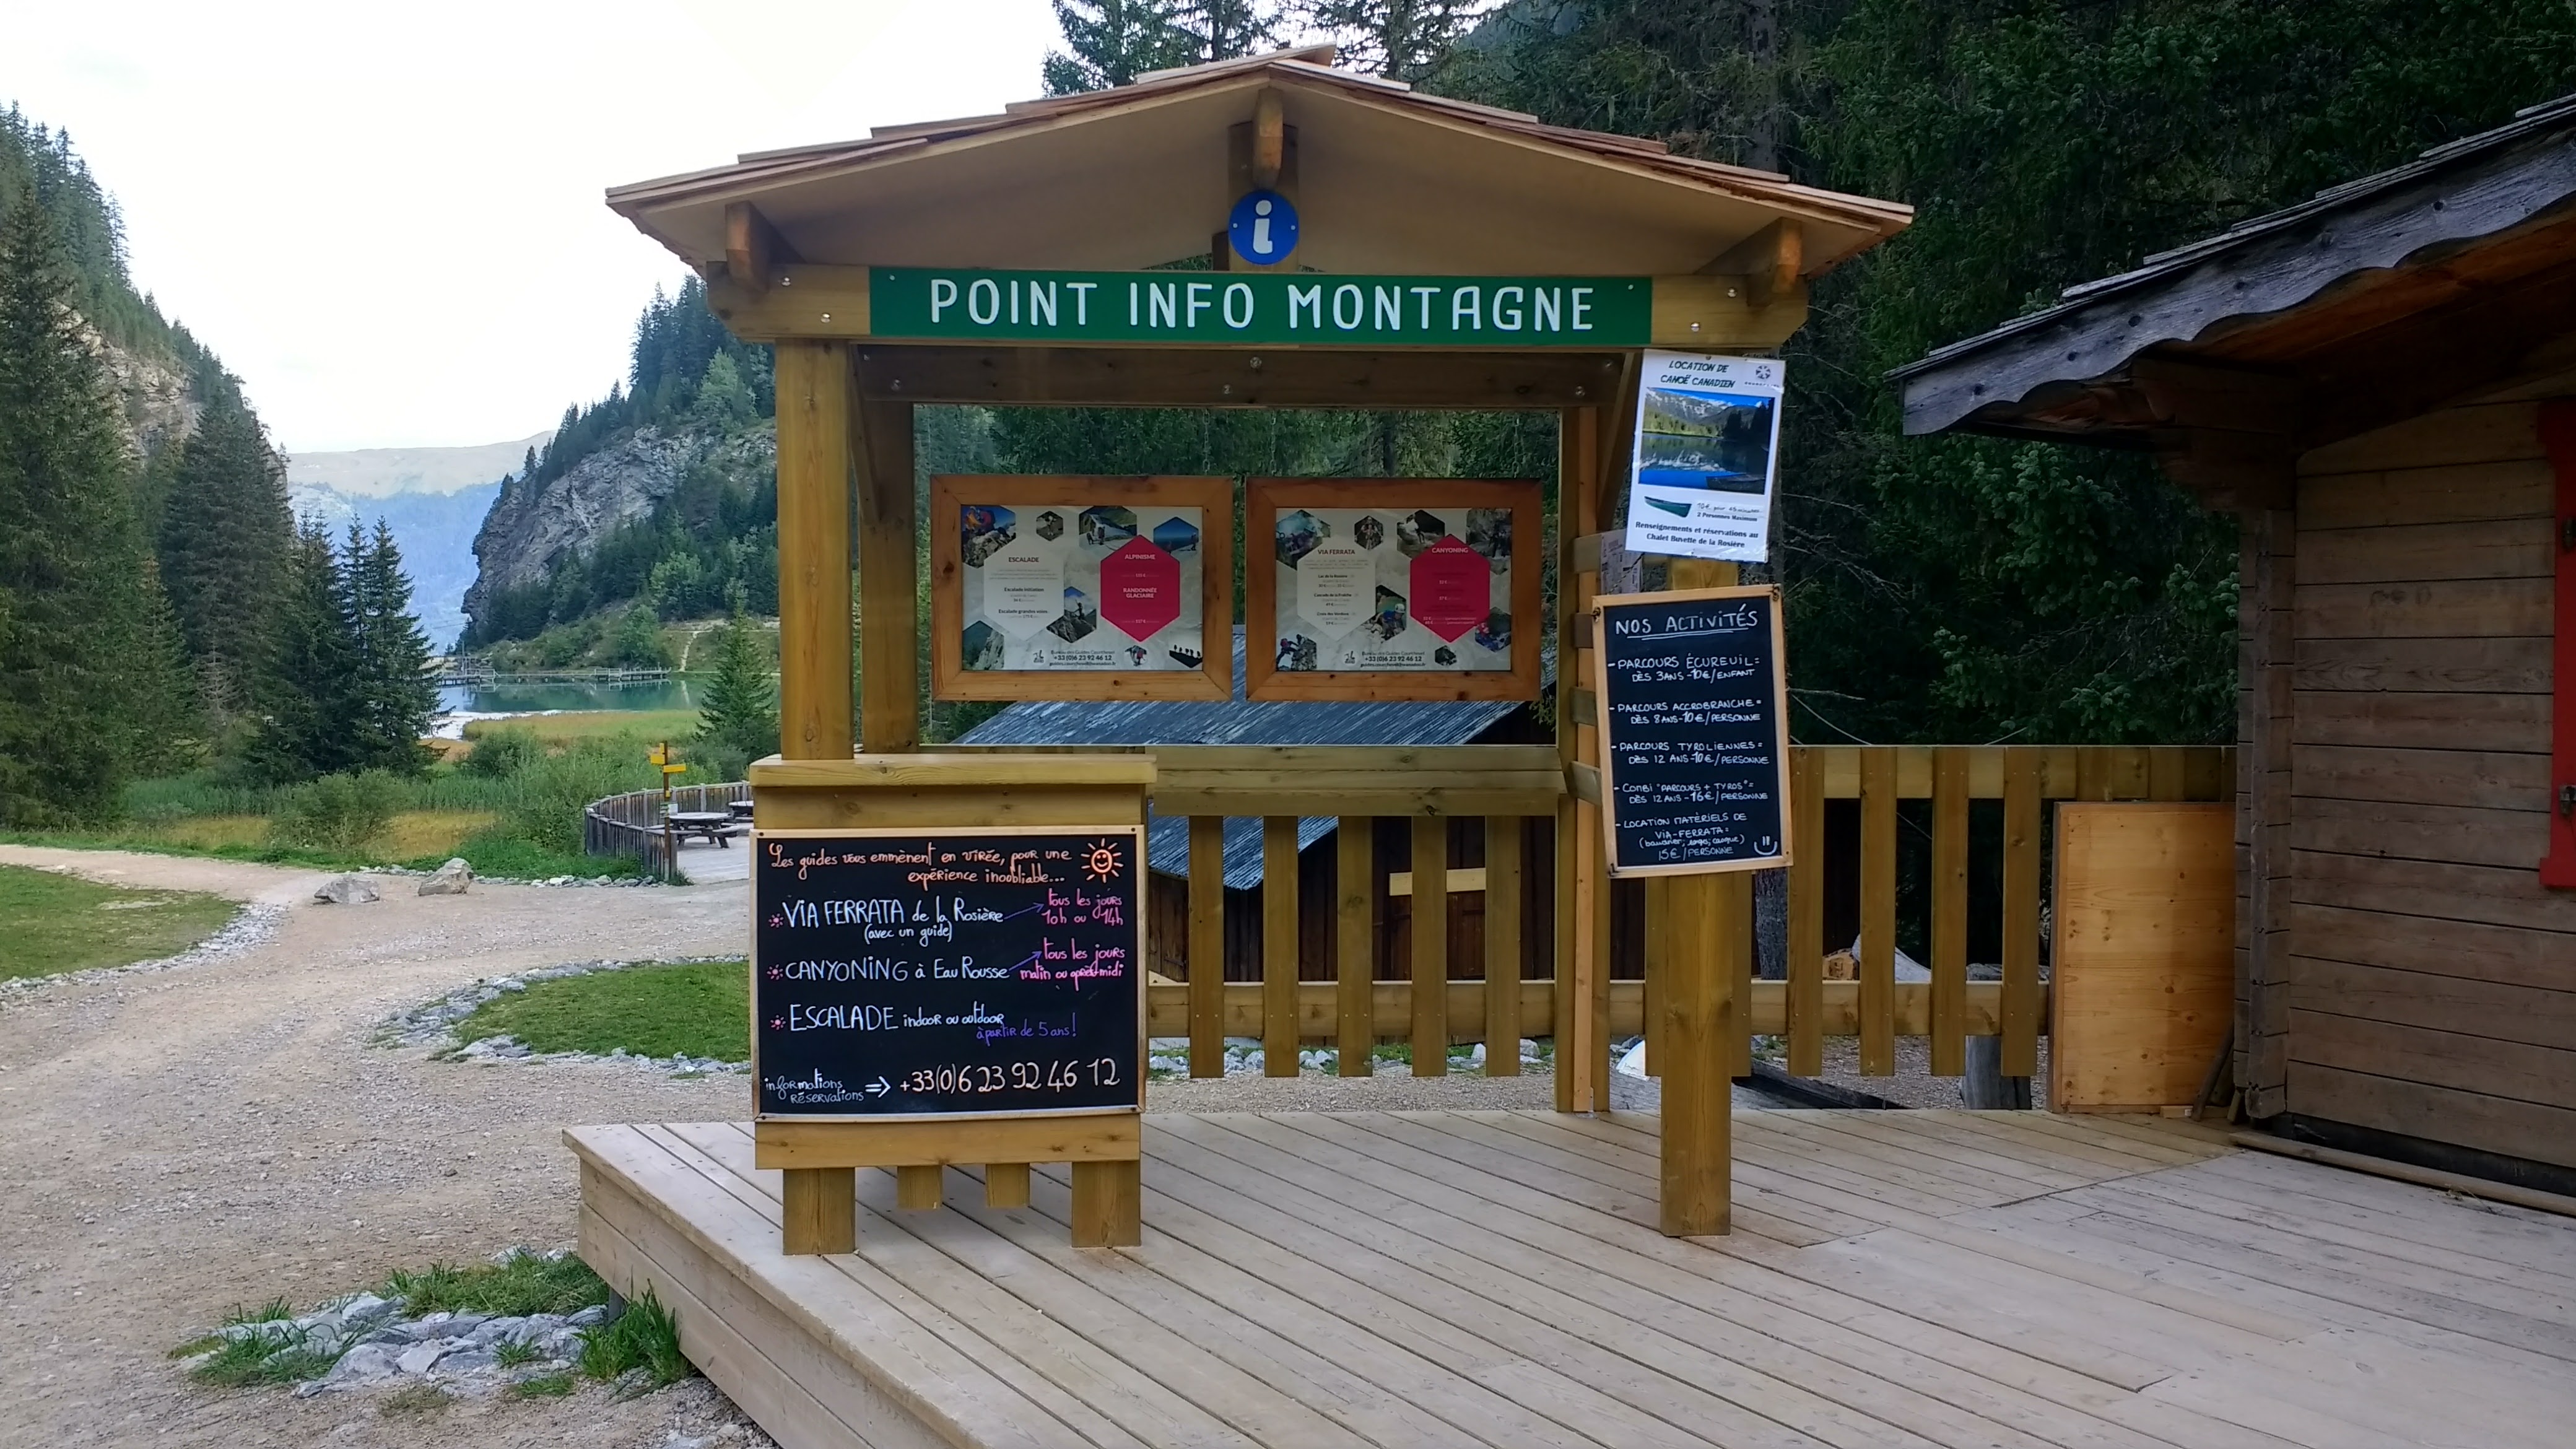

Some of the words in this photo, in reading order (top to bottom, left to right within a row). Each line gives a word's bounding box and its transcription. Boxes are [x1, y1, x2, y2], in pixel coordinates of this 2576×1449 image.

[1252, 199, 1273, 255] i
[930, 279, 1099, 329] POINT
[1129, 282, 1255, 330] INFO
[1287, 285, 1594, 333] MONTAGNE
[1669, 360, 1715, 372] LOCATION
[1717, 364, 1730, 372] DE
[1660, 375, 1691, 384] CANOË
[1692, 378, 1736, 388] CANADIEN
[1635, 521, 1692, 533] Renseignements
[1703, 528, 1747, 537] réservations
[1647, 533, 1669, 541] Chalet
[1671, 536, 1696, 544] Buvette
[1718, 539, 1745, 547] Rosière
[1616, 619, 1651, 634] NOS
[1666, 604, 1757, 632] ACTIVITÉS
[1618, 656, 1679, 669] PARCOURS
[1632, 671, 1651, 682] DÈS
[1618, 702, 1668, 713] PARCOURS
[1631, 715, 1650, 724] DÈS
[1620, 742, 1669, 752] PARCOURS
[1655, 755, 1665, 764] 12
[1630, 795, 1647, 804] DÈS
[1624, 817, 1670, 828] LOCATION
[1734, 813, 1747, 821] DE
[769, 843, 794, 867] Les
[798, 848, 837, 880] guides
[842, 853, 866, 863] vous
[870, 842, 936, 866] emmènent
[941, 855, 956, 863] en
[1010, 850, 1039, 872] pour
[1045, 851, 1073, 860] une
[908, 868, 978, 891] expérience
[782, 899, 819, 928] VIA
[824, 899, 904, 925] FERRATA
[912, 900, 929, 921] de
[936, 895, 948, 923] la
[954, 897, 1004, 923] Rosière
[1048, 888, 1070, 906] tous
[1077, 888, 1090, 905] les
[1092, 894, 1122, 919] jours
[1042, 907, 1067, 925] 10h
[1074, 914, 1086, 923] ou
[864, 923, 894, 945] (avec
[899, 928, 914, 936] un
[920, 921, 952, 947] guide)
[1043, 937, 1067, 959] tous
[1071, 938, 1087, 959] les
[1090, 944, 1125, 973] jours
[785, 956, 908, 981] CANYONING
[915, 964, 926, 978] à
[934, 959, 958, 978] Eau
[962, 956, 1010, 978] Rousse
[1020, 959, 1051, 980] matin
[1056, 969, 1068, 977] ou
[790, 1004, 899, 1031] ESCALADE
[903, 1006, 942, 1027] indoor
[946, 1016, 959, 1024] ou
[962, 1001, 1004, 1024] outdoor
[1020, 1018, 1034, 1037] de
[1039, 1022, 1048, 1036] 5
[765, 1068, 843, 1100] informations
[977, 1065, 1006, 1093] 23
[1012, 1063, 1042, 1089] 92
[1048, 1060, 1078, 1093] 46
[1086, 1058, 1120, 1086] 12
[790, 1088, 864, 1103] réservations
